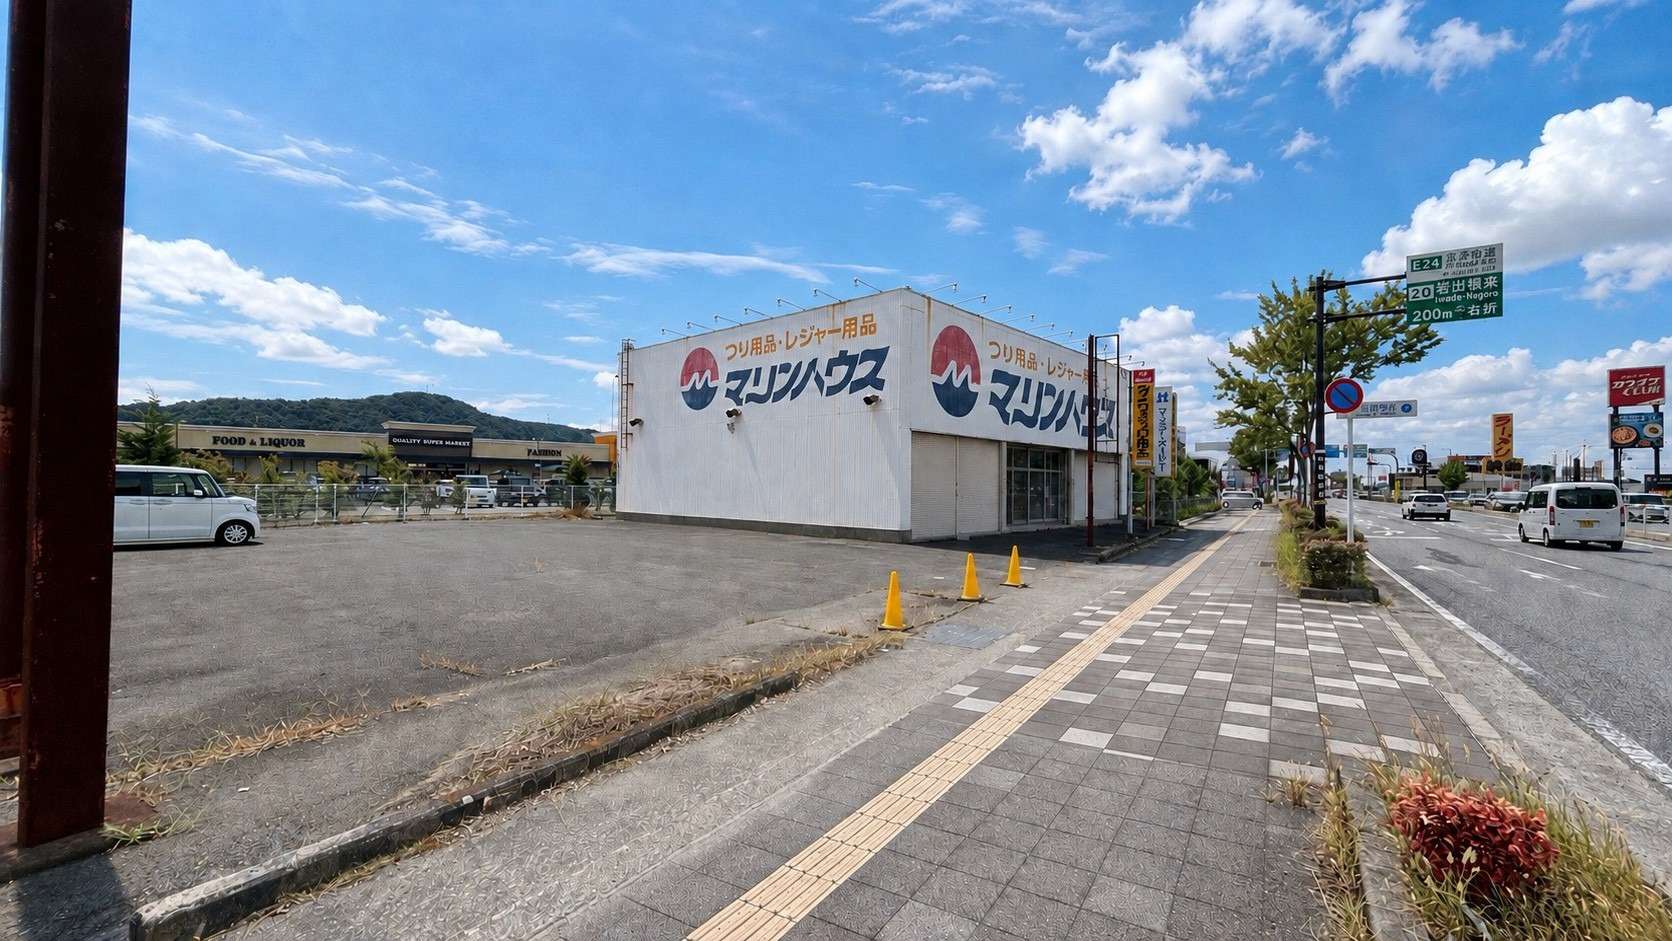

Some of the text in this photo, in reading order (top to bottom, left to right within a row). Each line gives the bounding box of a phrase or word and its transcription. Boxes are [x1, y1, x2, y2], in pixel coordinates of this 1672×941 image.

[1412, 258, 1440, 270] E24
[1411, 287, 1431, 299] 20
[725, 313, 877, 361] つり用品・レジャー用品
[725, 346, 890, 406] マリンハウス
[212, 436, 246, 445] FOOD
[260, 437, 305, 448] LIQUOR
[1495, 415, 1512, 458] ラーメン
